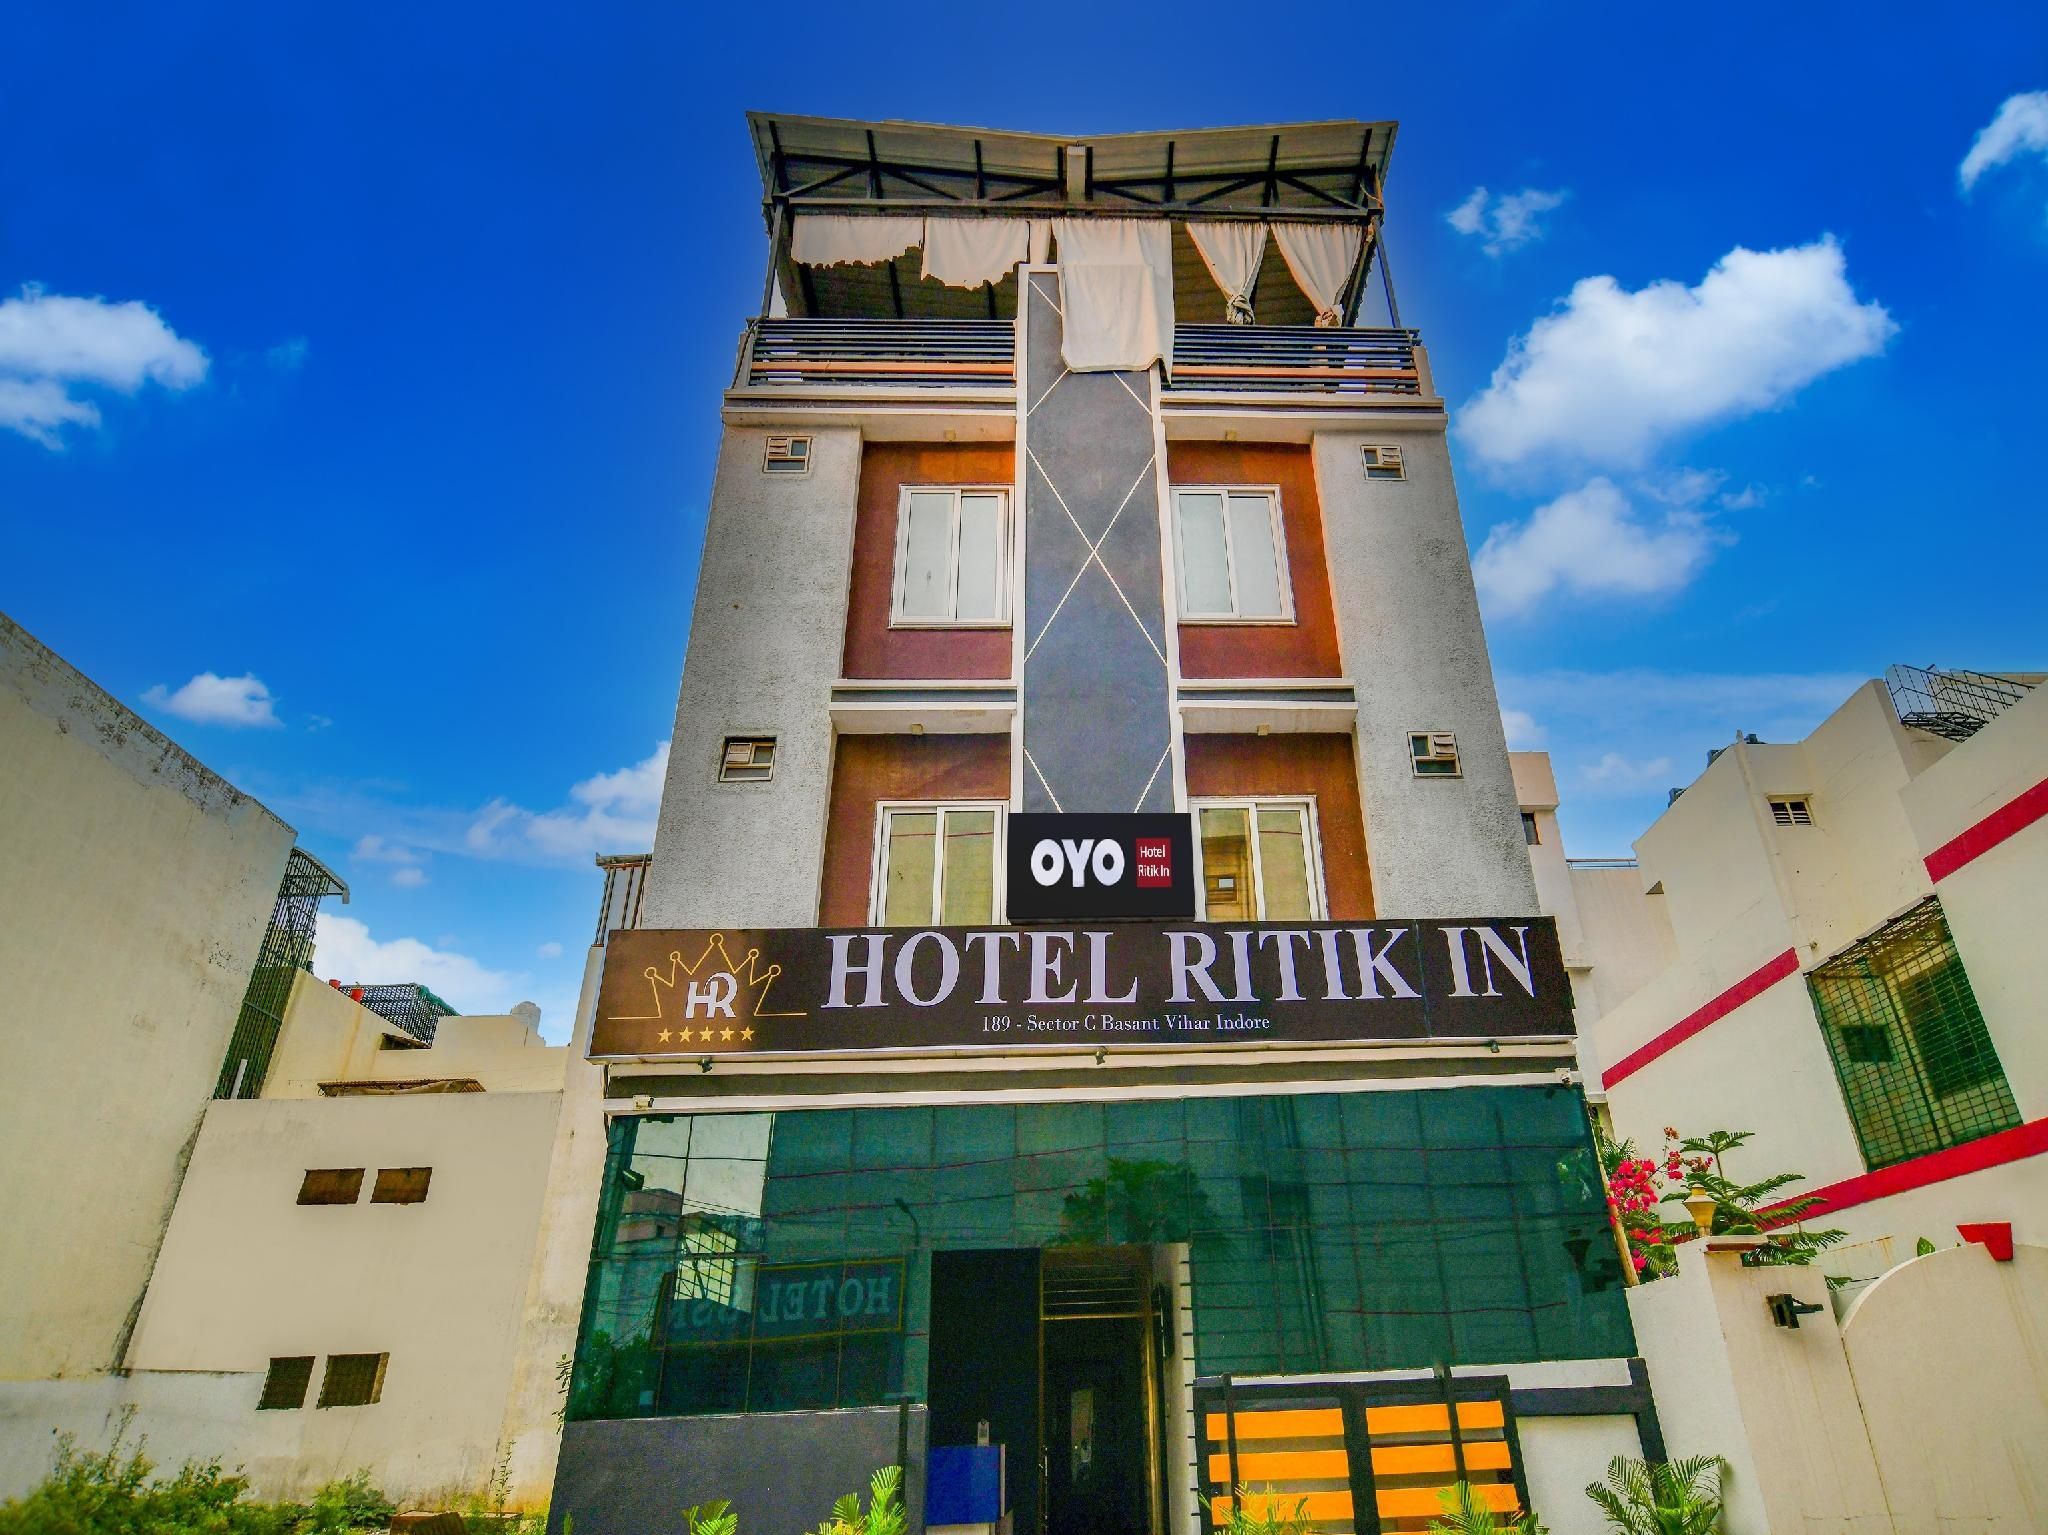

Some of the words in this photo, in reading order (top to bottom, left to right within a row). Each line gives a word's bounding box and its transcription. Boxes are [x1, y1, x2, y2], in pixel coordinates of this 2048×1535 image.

[1030, 838, 1126, 888] OYO
[1139, 844, 1166, 858] Hotel
[1137, 864, 1159, 877] Ritik
[1160, 864, 1170, 877] In
[820, 931, 1139, 1009] HOTEL
[1161, 928, 1423, 1002] RITIK
[1437, 926, 1536, 998] IN
[684, 971, 739, 1019] HR
[982, 1015, 1011, 1032] 189
[1027, 1014, 1080, 1032] Sector
[1084, 1014, 1096, 1031] C
[1101, 1014, 1160, 1031] Basant
[1164, 1013, 1211, 1031] Vihar
[1215, 1013, 1270, 1030] Indore
